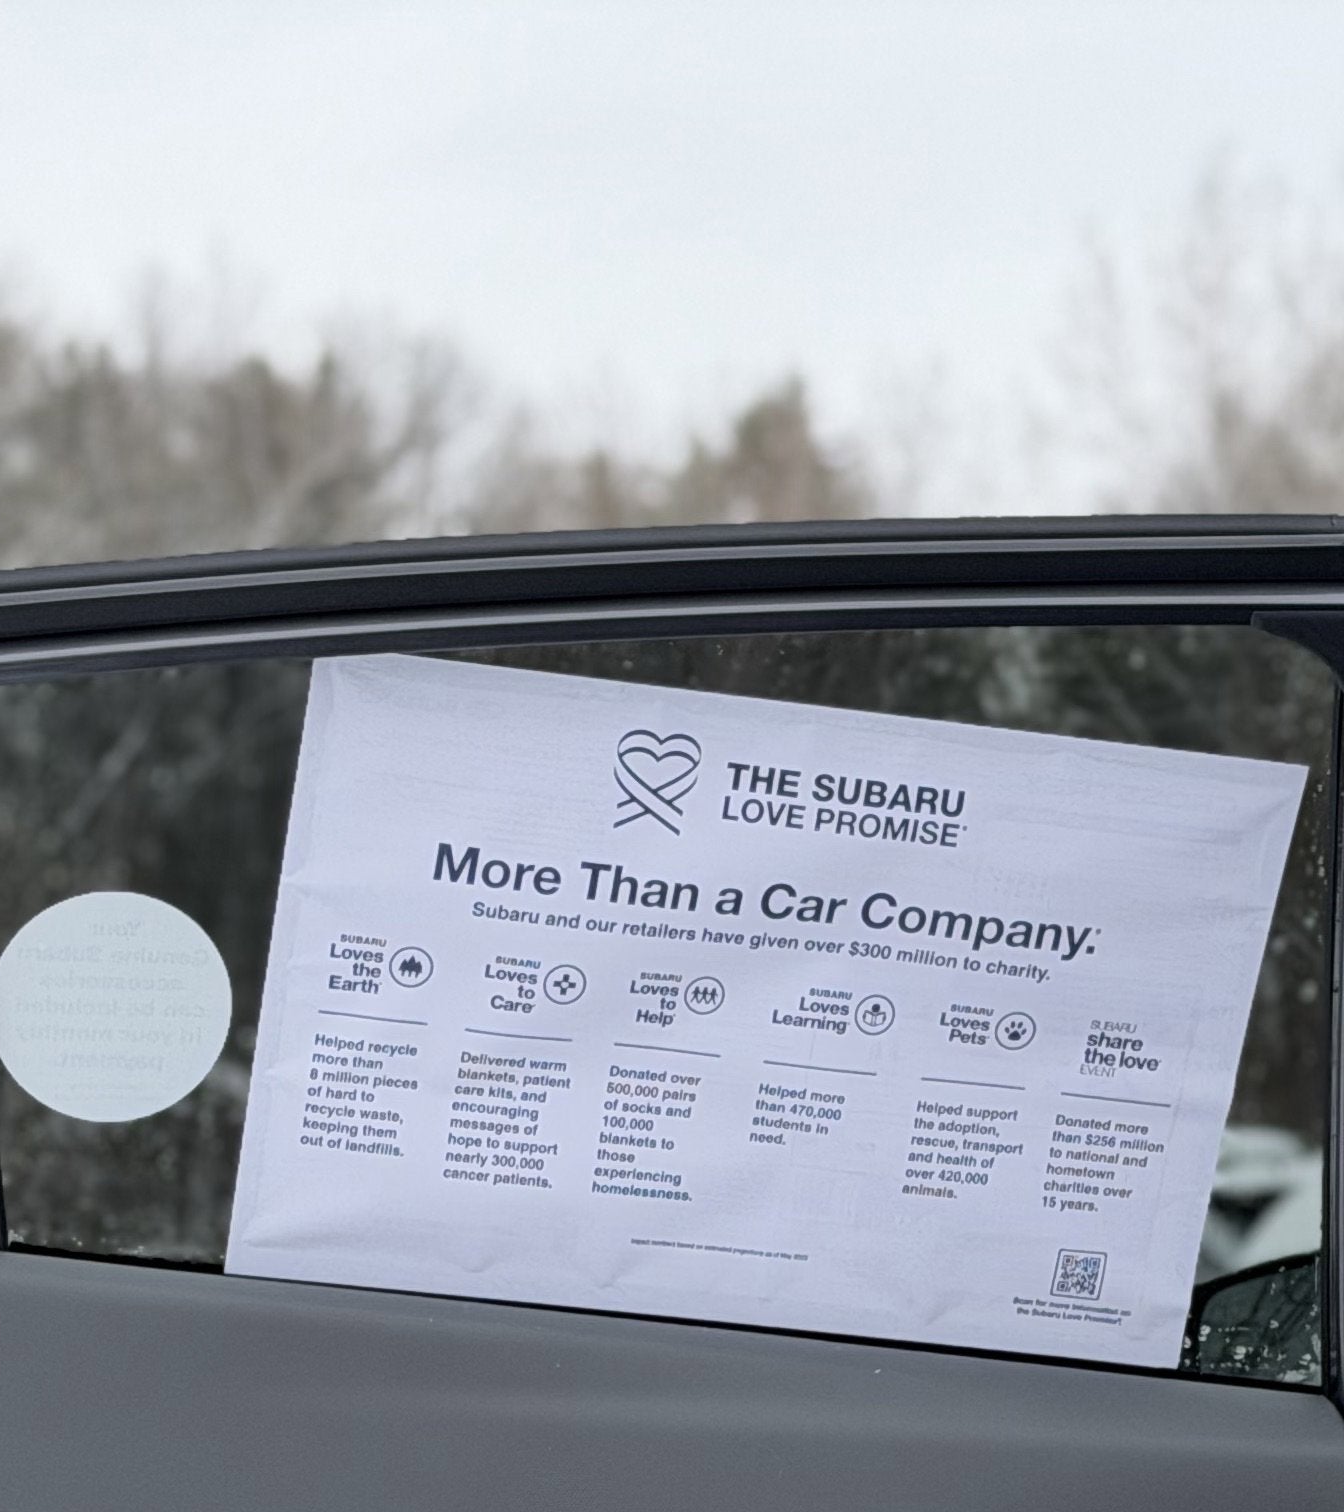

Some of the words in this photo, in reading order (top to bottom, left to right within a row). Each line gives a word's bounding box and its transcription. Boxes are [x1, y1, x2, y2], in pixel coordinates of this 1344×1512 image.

[726, 761, 801, 798] THE
[811, 773, 965, 817] SUBARU
[721, 794, 806, 829] LOVE
[432, 842, 561, 895] More
[580, 860, 699, 911] Than
[714, 887, 743, 916] a
[760, 882, 848, 924] Car
[339, 933, 387, 947] SUBARU
[471, 900, 540, 924] Subaru
[544, 913, 581, 929] and
[585, 918, 617, 933] our
[621, 922, 696, 941] retailers
[700, 927, 744, 945] have
[748, 931, 798, 950] given
[803, 939, 845, 954] over
[847, 941, 892, 959] $300
[895, 948, 957, 968] million
[962, 955, 981, 971] to
[985, 959, 1050, 983] charity.
[329, 942, 384, 963] Loves
[494, 955, 541, 969] SUBARU
[352, 961, 381, 978] the
[483, 963, 538, 985] Loves
[639, 971, 683, 983] SUBARU
[516, 984, 536, 1000] to
[629, 979, 679, 997] Loves
[808, 987, 853, 1000] SUBARU
[659, 997, 677, 1010] to
[798, 995, 849, 1016] Loves
[949, 1003, 994, 1016] SUBARU
[939, 1011, 990, 1031] Loves
[1089, 1019, 1137, 1034] SUBARU
[314, 1032, 364, 1051] Helped
[367, 1042, 417, 1056] recycle
[1085, 1031, 1143, 1051] share
[311, 1052, 348, 1066] more
[352, 1055, 383, 1070] than
[460, 1050, 526, 1068] Delivered
[529, 1059, 567, 1072] warm
[1081, 1047, 1116, 1068] the
[309, 1067, 318, 1080] 8
[321, 1070, 369, 1085] million
[372, 1074, 418, 1090] pieces
[456, 1067, 519, 1085] blankets,
[522, 1074, 571, 1089] patient
[608, 1064, 667, 1082] Donated
[669, 1074, 701, 1086] over
[1079, 1064, 1116, 1077] EVENT
[306, 1085, 322, 1097] of
[325, 1085, 357, 1101] hard
[360, 1089, 375, 1102] to
[453, 1084, 484, 1096] care
[487, 1085, 516, 1102] kits,
[519, 1091, 547, 1103] and
[605, 1080, 659, 1098] 500,000
[661, 1088, 696, 1102] pairs
[757, 1082, 807, 1100] Helped
[809, 1091, 845, 1104] more
[304, 1102, 355, 1118] recycle
[359, 1109, 403, 1125] waste,
[451, 1101, 539, 1122] encouraging
[603, 1098, 619, 1111] of
[621, 1101, 662, 1115] socks
[664, 1106, 692, 1118] and
[755, 1098, 786, 1113] than
[788, 1103, 841, 1120] 470,000
[916, 1099, 963, 1116] Helped
[965, 1107, 1018, 1121] support
[302, 1116, 358, 1137] keeping
[362, 1124, 397, 1139] them
[449, 1117, 519, 1135] messages
[523, 1123, 538, 1136] of
[602, 1114, 654, 1131] 100,000
[751, 1116, 811, 1133] students
[815, 1122, 828, 1135] in
[913, 1116, 935, 1130] the
[937, 1119, 1000, 1138] adoption,
[1054, 1113, 1112, 1131] Donated
[1113, 1122, 1149, 1135] more
[299, 1134, 323, 1147] out
[326, 1137, 342, 1149] of
[344, 1138, 404, 1157] landfills.
[447, 1131, 482, 1149] hope
[485, 1136, 500, 1149] to
[503, 1140, 558, 1155] support
[598, 1130, 657, 1148] blankets
[660, 1137, 674, 1150] to
[749, 1132, 786, 1145] need.
[910, 1135, 958, 1151] rescue,
[962, 1138, 1023, 1155] transport
[1051, 1130, 1081, 1144] than
[1084, 1133, 1116, 1148] $256
[1119, 1138, 1164, 1152] million
[444, 1151, 488, 1167] nearly
[490, 1153, 544, 1171] 300,000
[596, 1148, 635, 1163] those
[907, 1151, 933, 1163] and
[935, 1151, 977, 1167] health
[980, 1156, 995, 1168] of
[1048, 1146, 1062, 1158] to
[1065, 1149, 1120, 1164] national
[1121, 1155, 1148, 1167] and
[442, 1168, 490, 1182] cancer
[492, 1172, 552, 1188] patients.
[593, 1166, 681, 1187] experiencing
[904, 1168, 935, 1180] over
[937, 1168, 988, 1185] 420,000
[1045, 1162, 1115, 1180] hometown
[591, 1180, 692, 1201] homelessness.
[901, 1183, 957, 1199] animals.
[1043, 1179, 1099, 1195] charities
[1102, 1186, 1133, 1198] over
[1041, 1195, 1056, 1208] 15
[1059, 1199, 1098, 1212] years.
